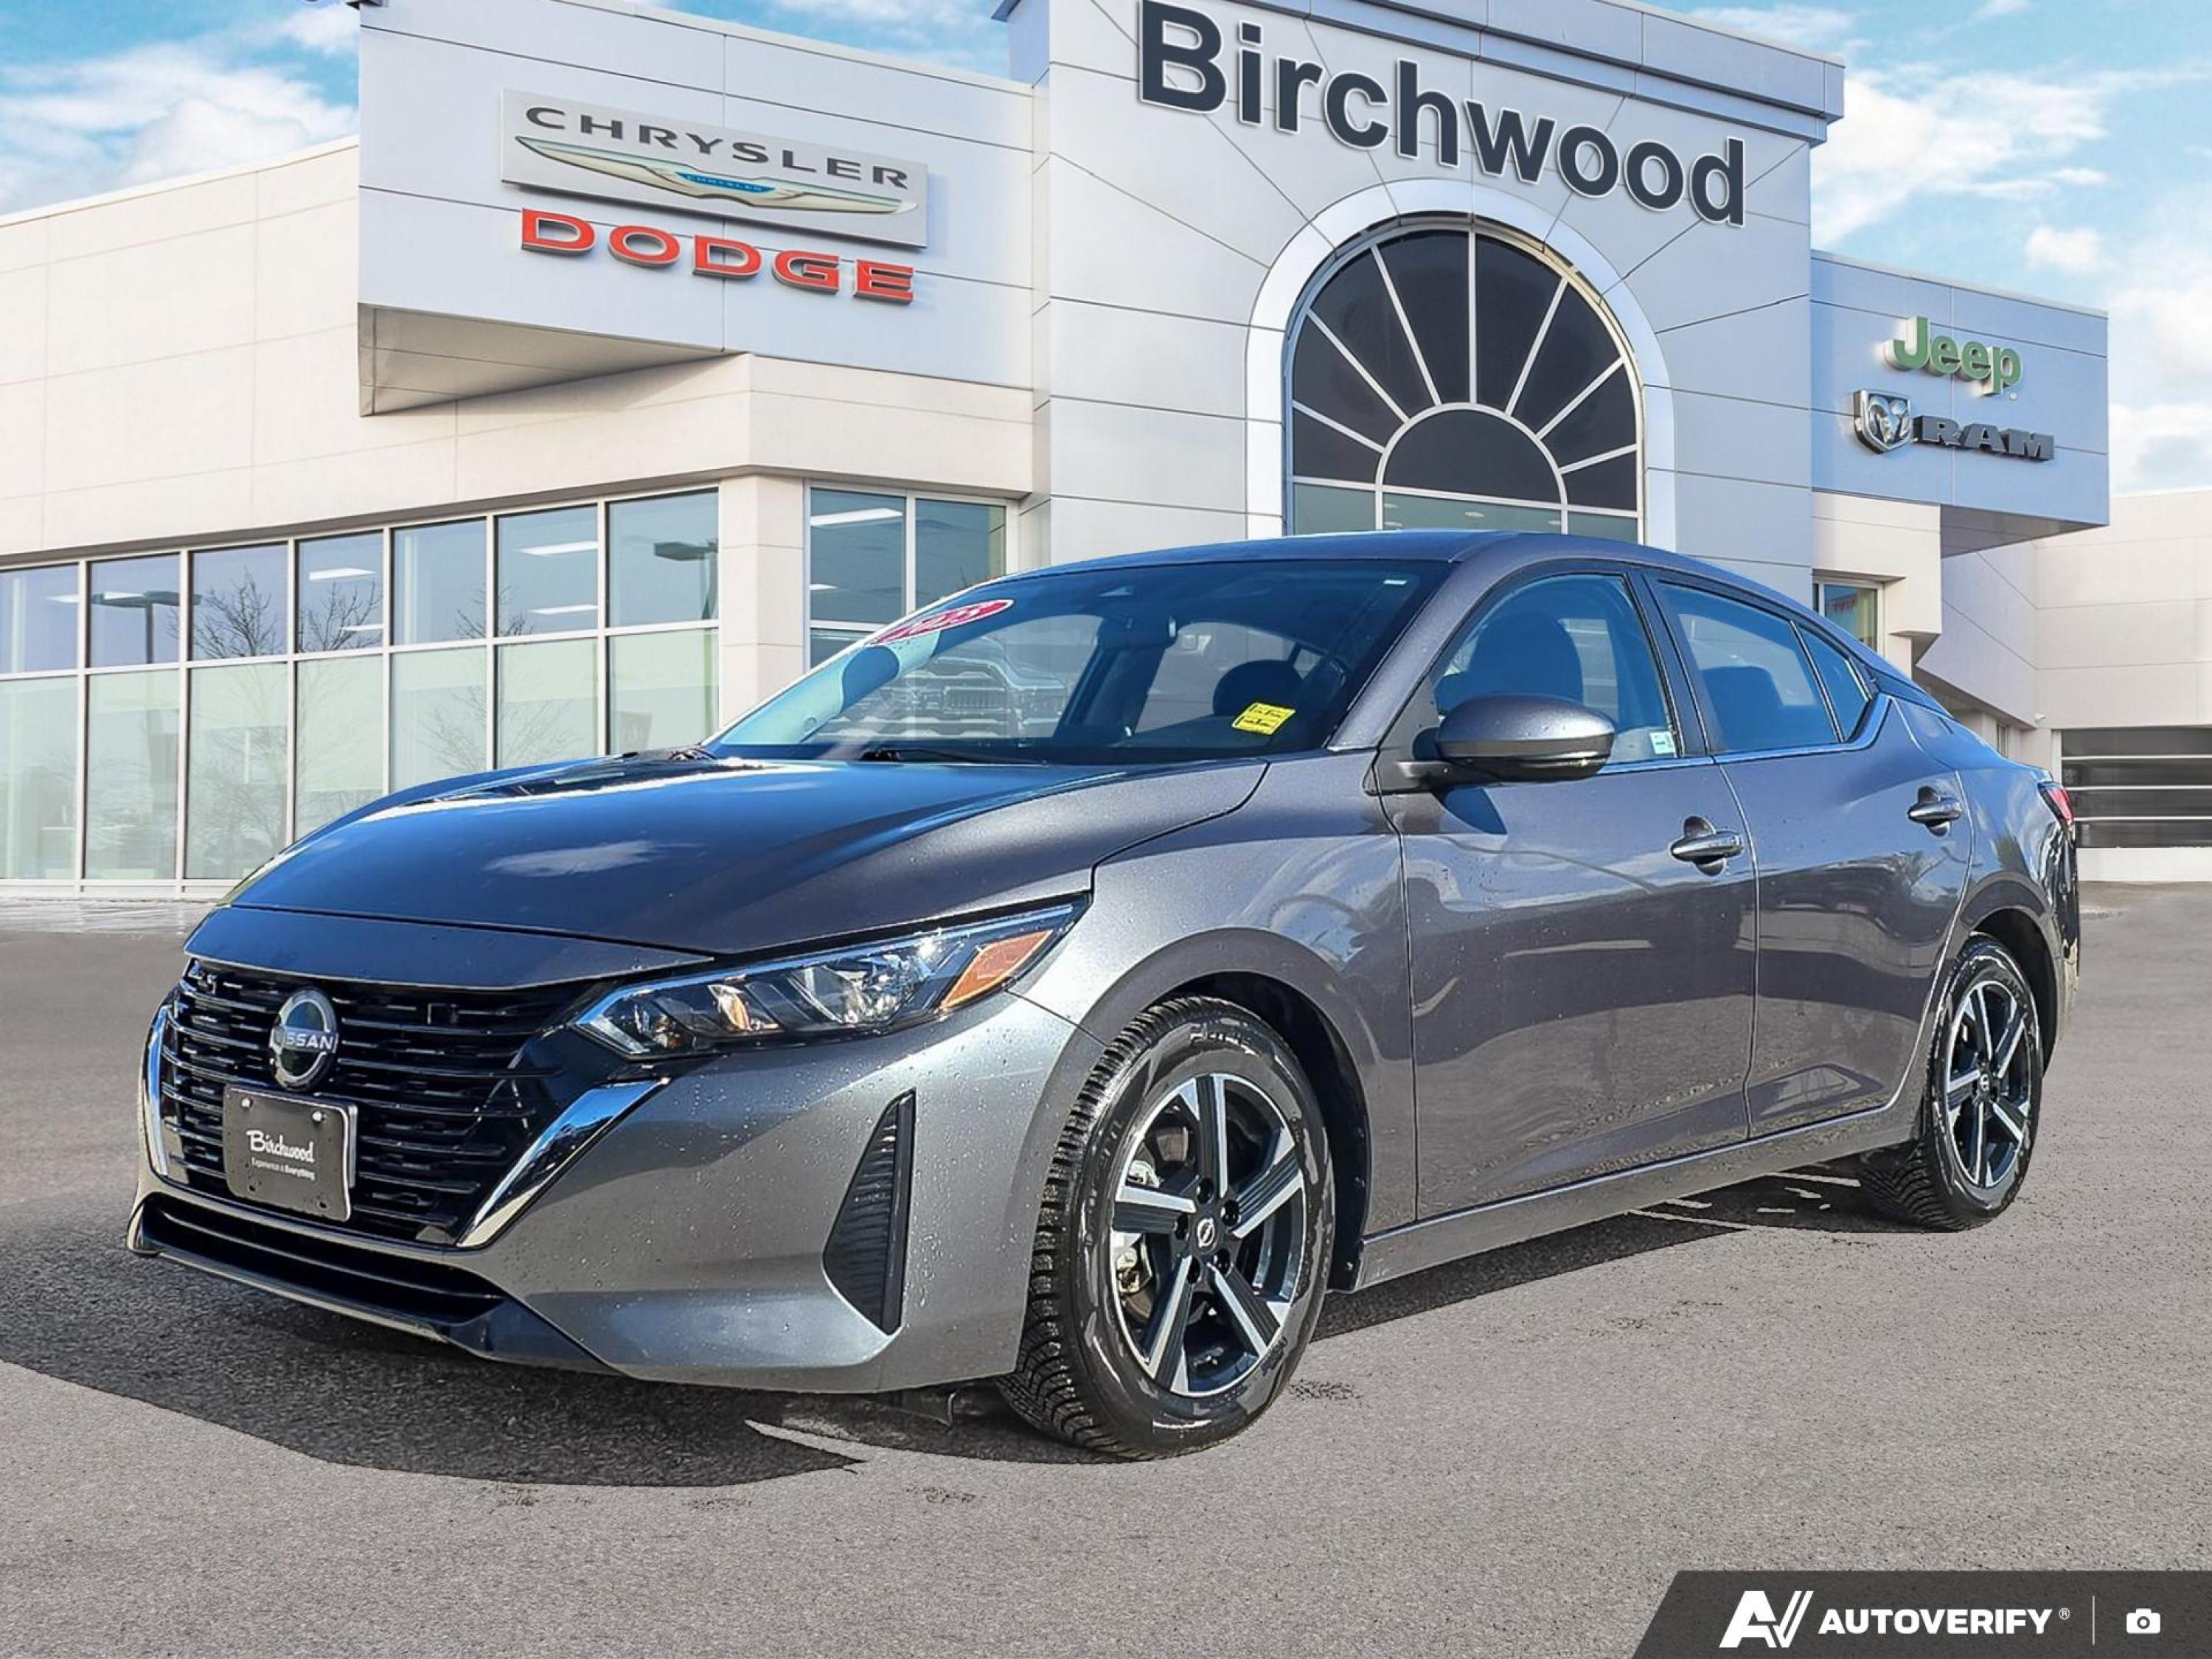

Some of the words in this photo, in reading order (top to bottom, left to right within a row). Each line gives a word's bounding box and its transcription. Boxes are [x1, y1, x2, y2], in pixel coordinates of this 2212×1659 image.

[525, 106, 908, 189] CHRYSLER
[1139, 0, 1745, 227] Birchwood
[521, 208, 914, 305] DODGE
[1884, 316, 2023, 396] Jeep
[1913, 415, 2055, 461] RAM
[274, 1030, 334, 1050] SSAN
